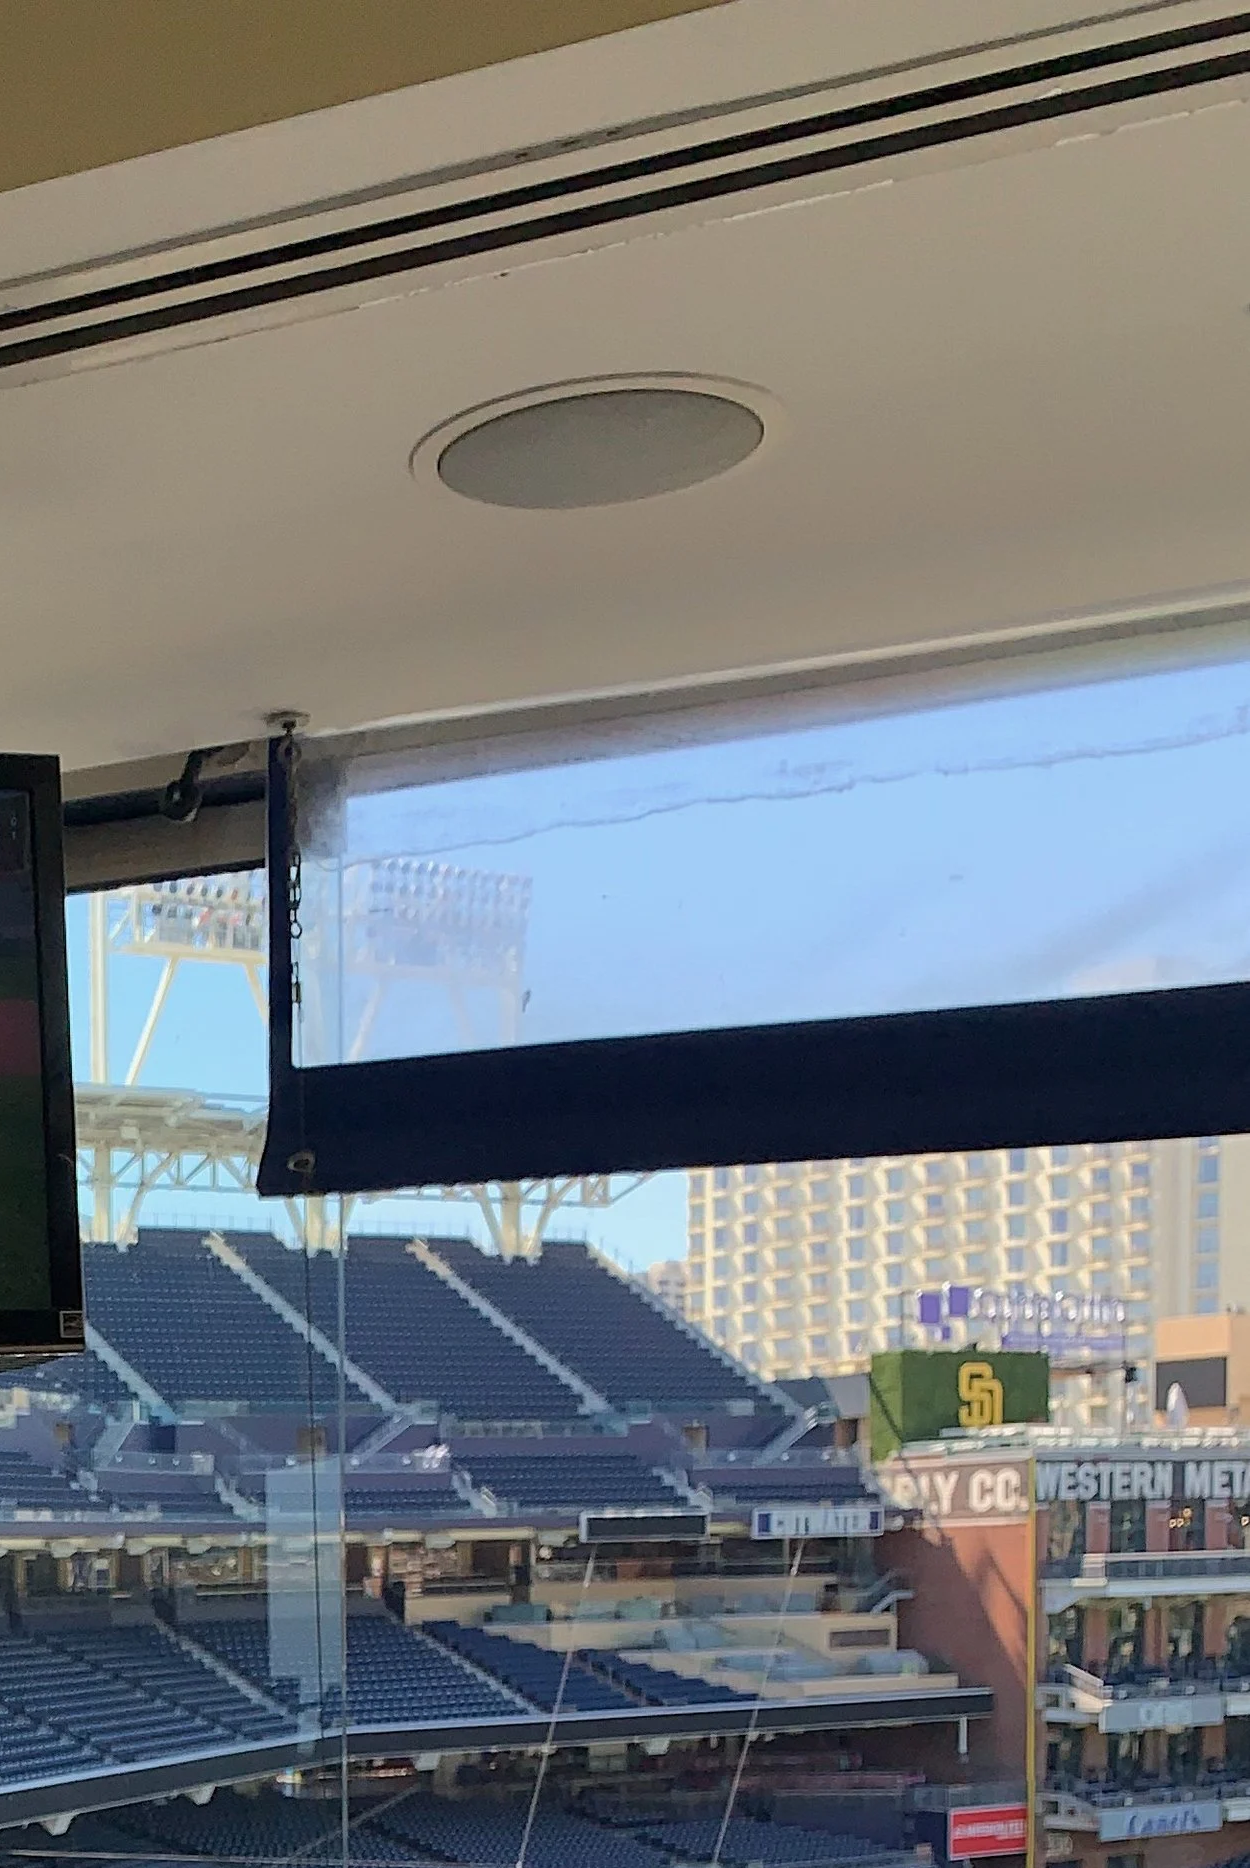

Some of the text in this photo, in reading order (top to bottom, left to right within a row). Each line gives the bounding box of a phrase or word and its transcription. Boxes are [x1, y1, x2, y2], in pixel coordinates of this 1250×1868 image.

[958, 1361, 1003, 1427] SD
[969, 1467, 1030, 1514] CO.
[1036, 1460, 1174, 1500] WESTERN
